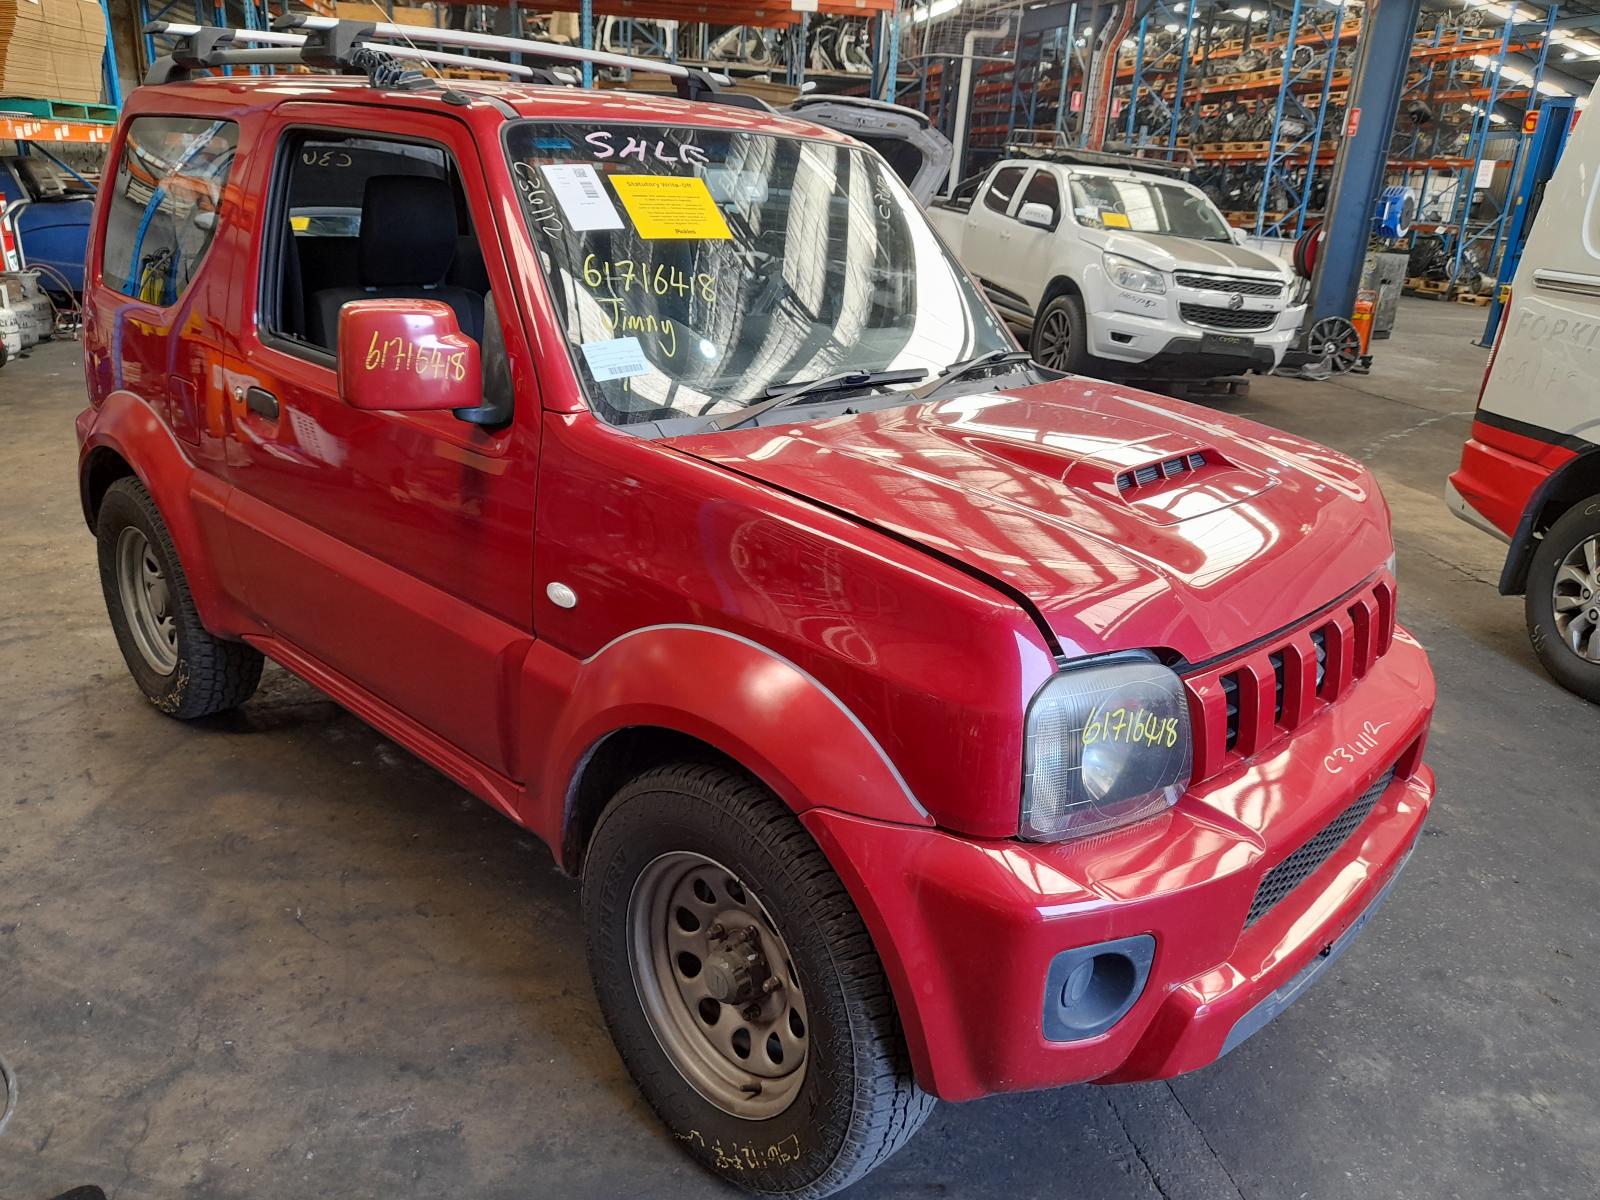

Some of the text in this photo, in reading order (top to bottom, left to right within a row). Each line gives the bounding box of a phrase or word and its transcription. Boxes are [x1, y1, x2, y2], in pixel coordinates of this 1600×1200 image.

[585, 131, 709, 164] SALE
[583, 253, 717, 302] 61716418
[365, 330, 466, 381] 61716418
[1081, 706, 1180, 749] 61716418
